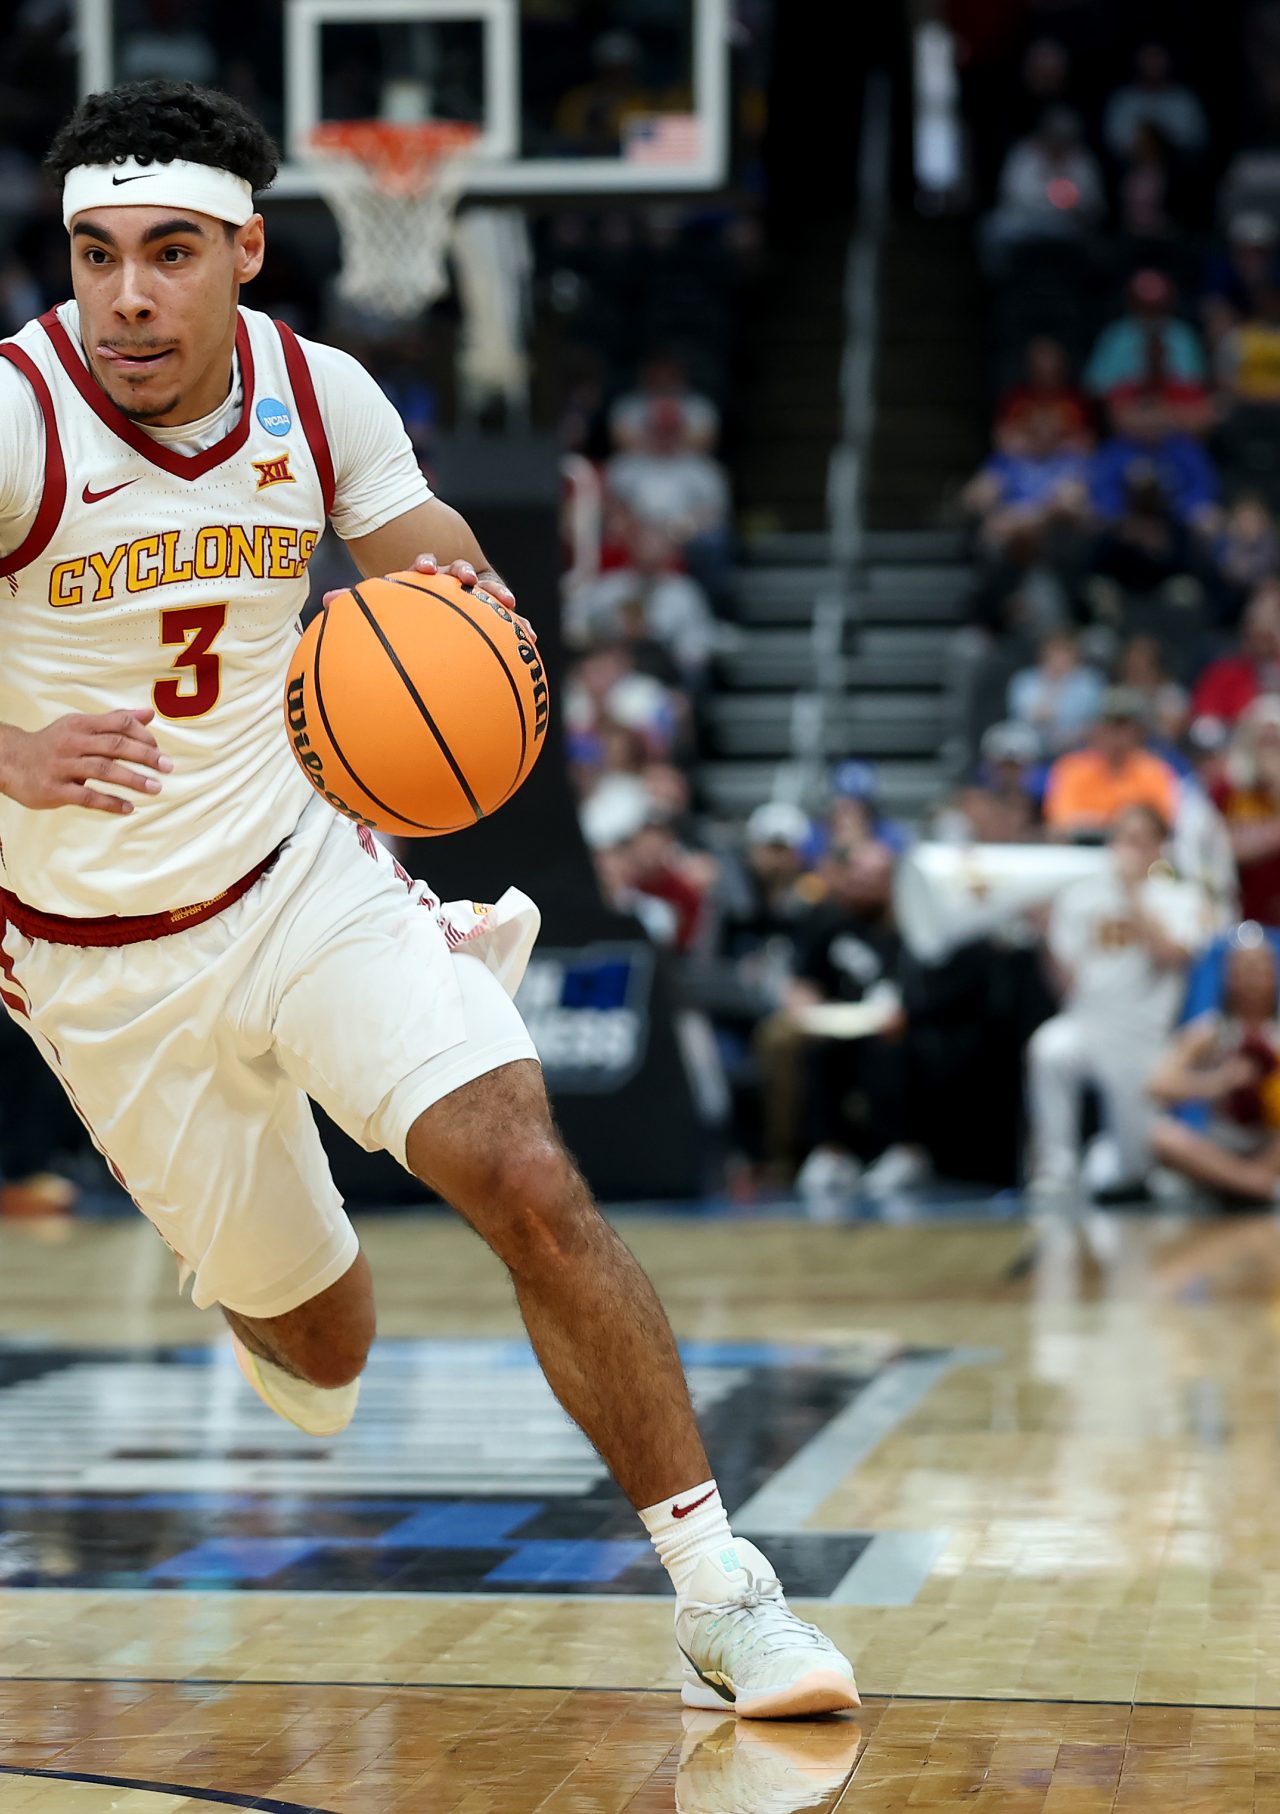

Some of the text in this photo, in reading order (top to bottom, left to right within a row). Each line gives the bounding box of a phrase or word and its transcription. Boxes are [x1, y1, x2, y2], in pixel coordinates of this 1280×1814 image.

[263, 414, 291, 427] NCAA
[250, 450, 297, 492] XII
[48, 525, 319, 607] CYCLONES
[151, 601, 229, 721] 3
[286, 671, 378, 828] Wilson
